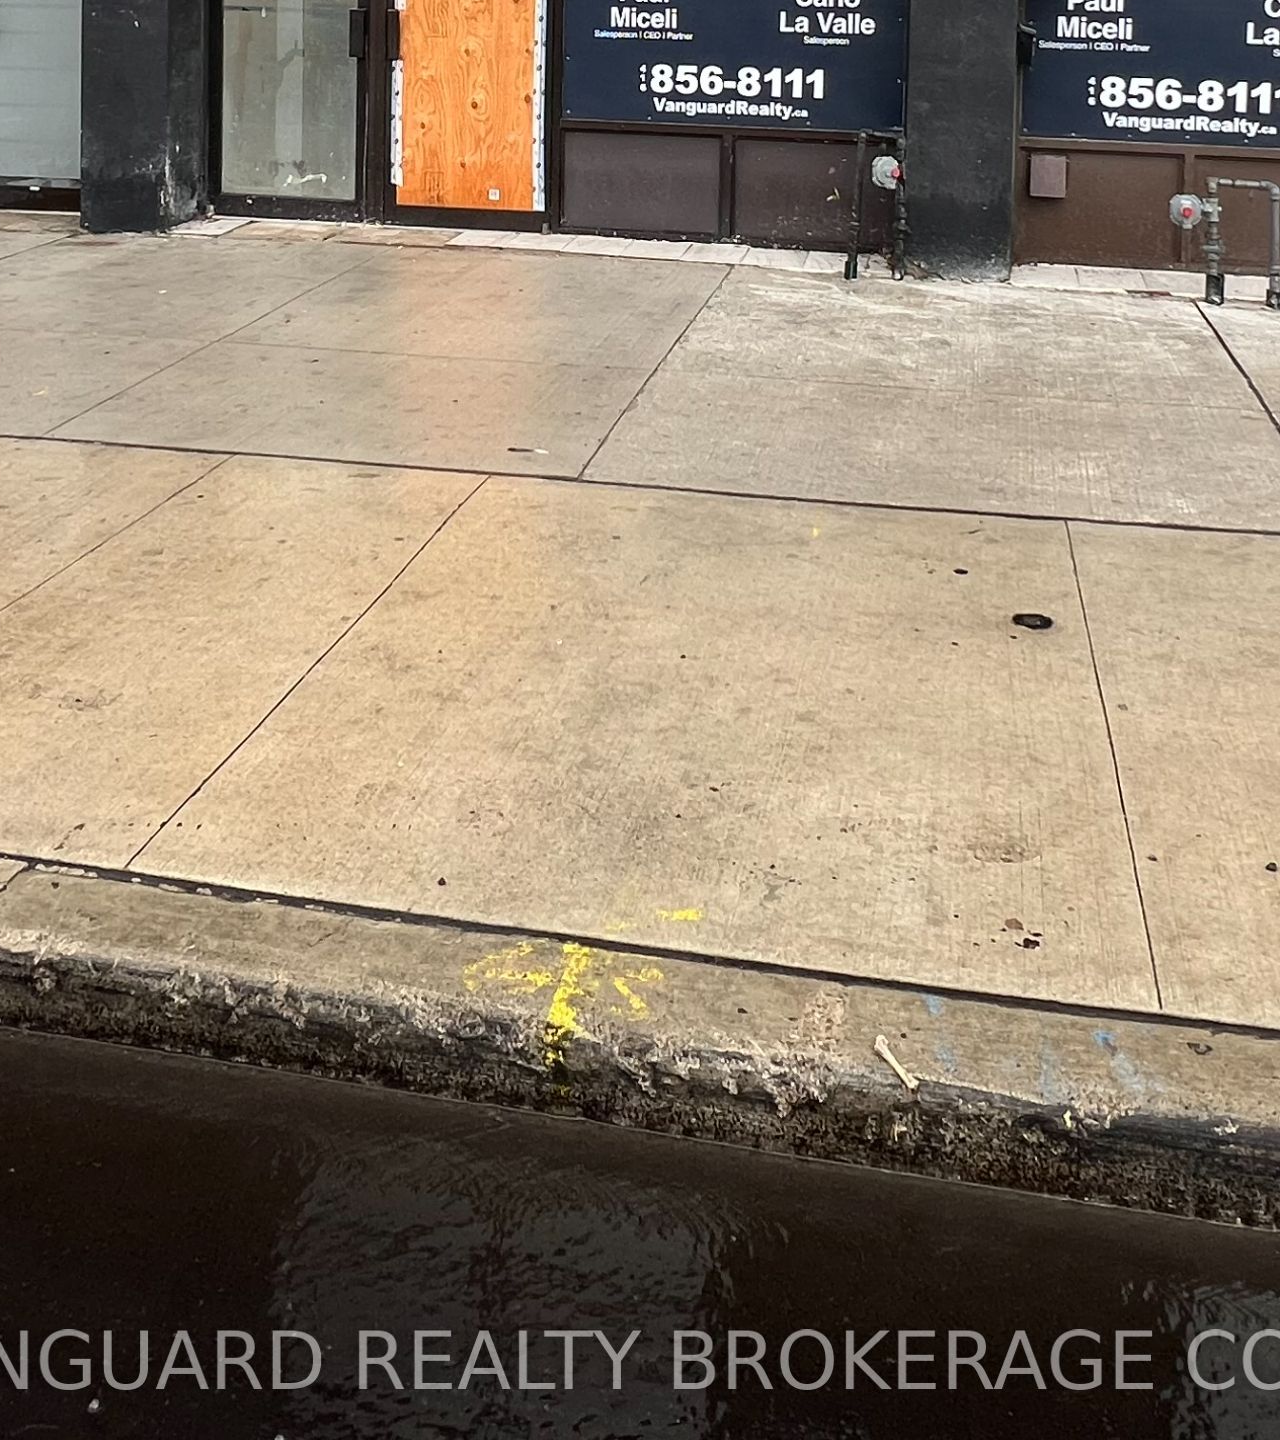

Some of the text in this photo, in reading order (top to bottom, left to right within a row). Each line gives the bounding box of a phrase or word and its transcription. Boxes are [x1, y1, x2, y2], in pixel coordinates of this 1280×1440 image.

[609, 6, 678, 29] Miceli
[779, 11, 876, 35] La Valle
[1056, 15, 1134, 41] Miceli
[1245, 22, 1280, 46] La
[650, 63, 825, 100] 856-8111
[652, 96, 809, 120] VanguardRealty.ca
[1102, 111, 1278, 137] VanguardRealty.ca
